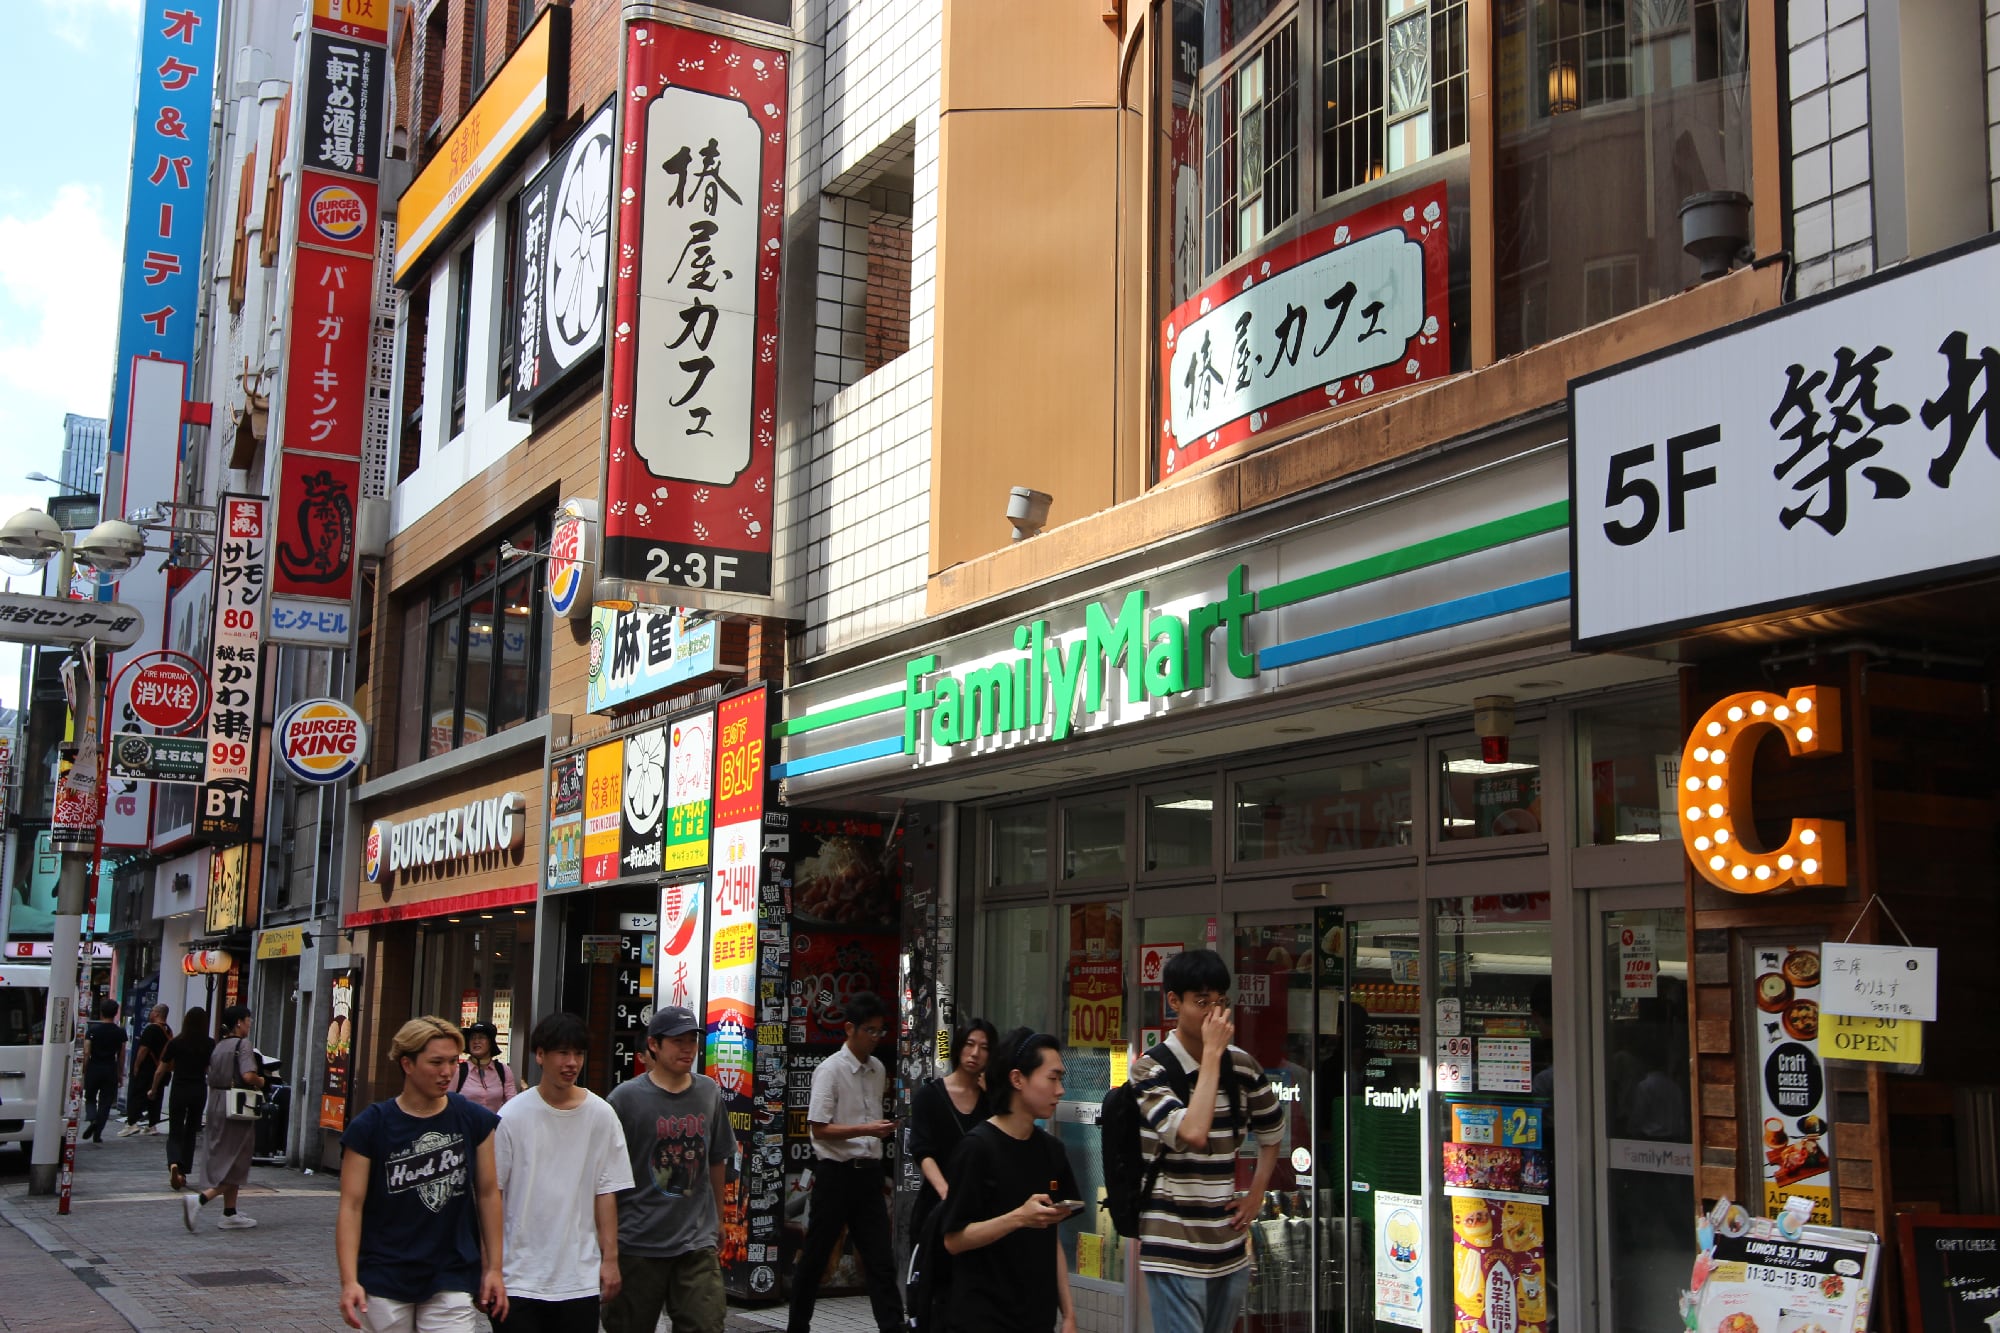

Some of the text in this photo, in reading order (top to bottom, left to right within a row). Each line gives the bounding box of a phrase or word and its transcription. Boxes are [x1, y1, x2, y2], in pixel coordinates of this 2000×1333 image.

[340, 24, 361, 36] 4F
[318, 45, 360, 170] 一軒め酒場
[315, 199, 362, 226] BURGER KING
[516, 191, 544, 392] 一軒め酒場
[661, 137, 744, 438] 椿屋カフェ
[310, 264, 348, 443] バーガーキング
[1184, 280, 1388, 420] 椿屋カフェ
[1602, 423, 1722, 547] 5F
[221, 543, 245, 606] サワー
[242, 539, 264, 606] レモン
[223, 608, 254, 630] 80
[272, 607, 348, 634] センタービル
[215, 644, 256, 663] 秘伝
[904, 563, 1256, 756] FamilyMart
[143, 669, 189, 681] FIRE HYDRANT
[136, 681, 194, 710] 消火栓
[287, 719, 357, 760] BURGER KING
[155, 749, 204, 764] 宝石広場
[211, 742, 247, 766] 99
[720, 738, 762, 801] B1F
[1678, 684, 1846, 894] C
[389, 791, 515, 872] BURGER KING
[672, 798, 707, 838] 삼겹살
[595, 857, 608, 878] 4F
[622, 840, 661, 870] 一軒め酒場
[715, 864, 756, 916] 건배!
[1831, 957, 1862, 977] 空席
[619, 970, 639, 993] 4F
[1237, 975, 1266, 992] 銀行
[1854, 978, 1900, 998] あります
[1237, 993, 1266, 1006] ATM
[617, 1004, 638, 1028] 3F
[1835, 1032, 1899, 1053] OPEN
[1778, 1052, 1806, 1073] Craft
[1777, 1072, 1809, 1088] CHEESE
[1778, 1091, 1810, 1107] MARKET
[390, 1157, 436, 1187] Hard
[1745, 1241, 1829, 1263] LUNCH SET MENU
[1935, 1239, 1963, 1251] CRAFT
